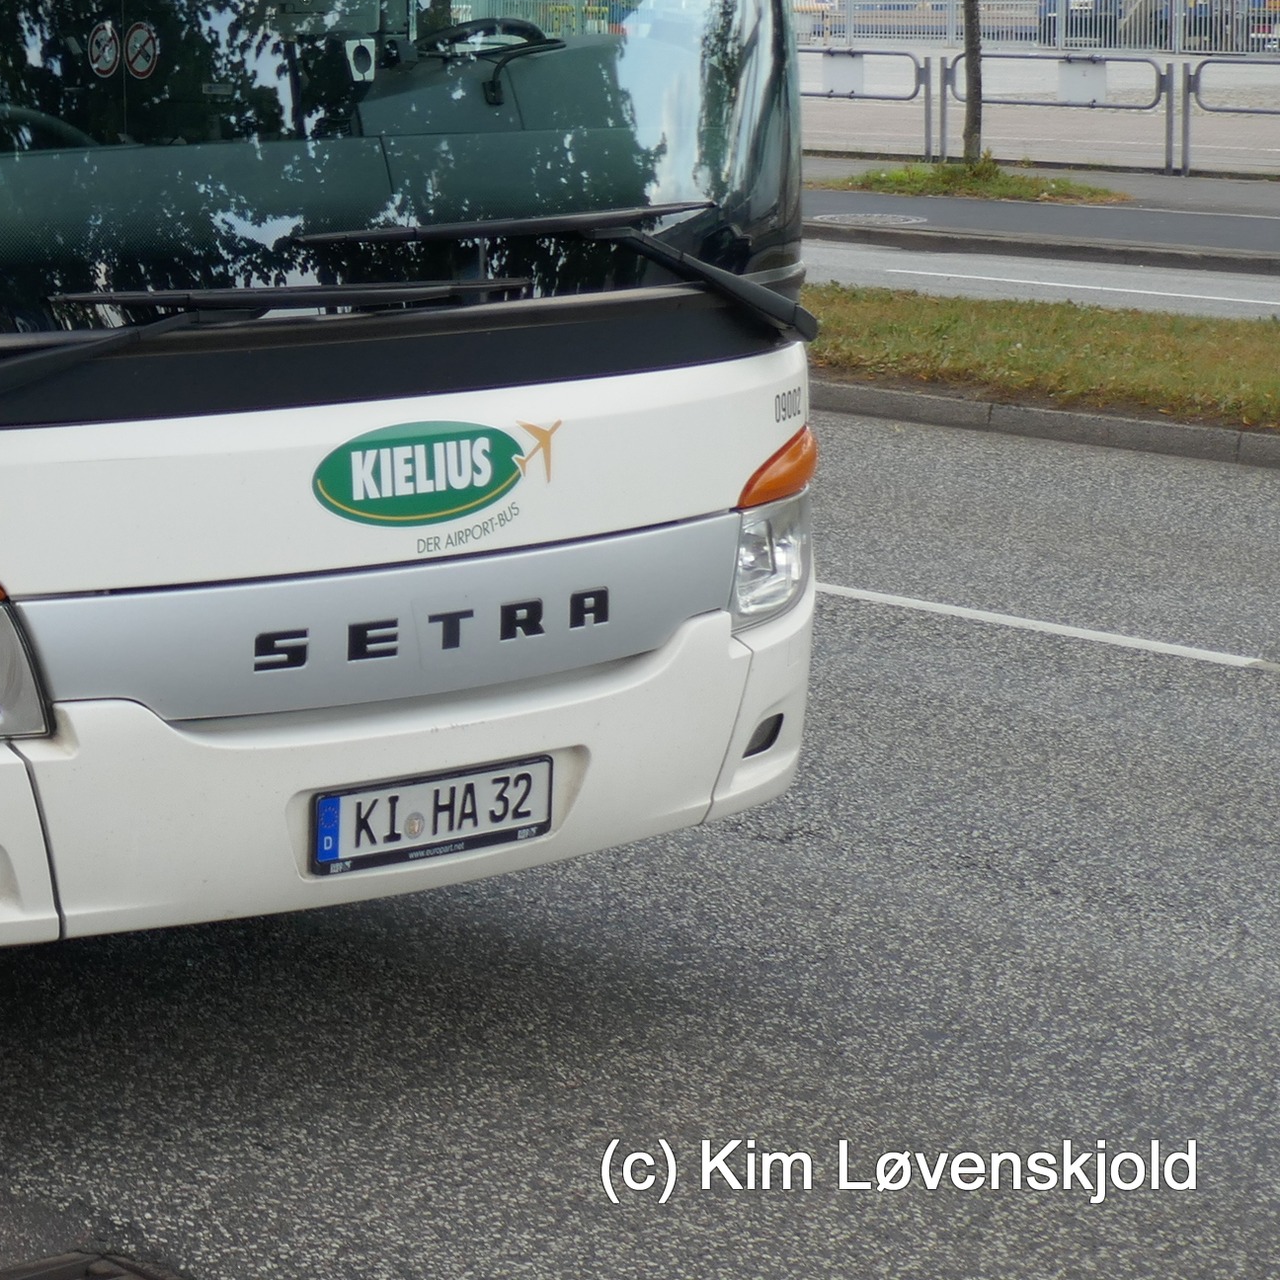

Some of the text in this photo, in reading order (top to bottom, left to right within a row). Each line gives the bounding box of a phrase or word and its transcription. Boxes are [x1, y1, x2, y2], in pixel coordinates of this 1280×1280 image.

[351, 437, 492, 501] KIELIUS
[416, 502, 520, 554] DER AIRPORT-BUS
[253, 586, 609, 672] SETRA
[355, 773, 532, 848] KI HA 32
[323, 836, 333, 850] D
[408, 842, 465, 859] www.europart.net
